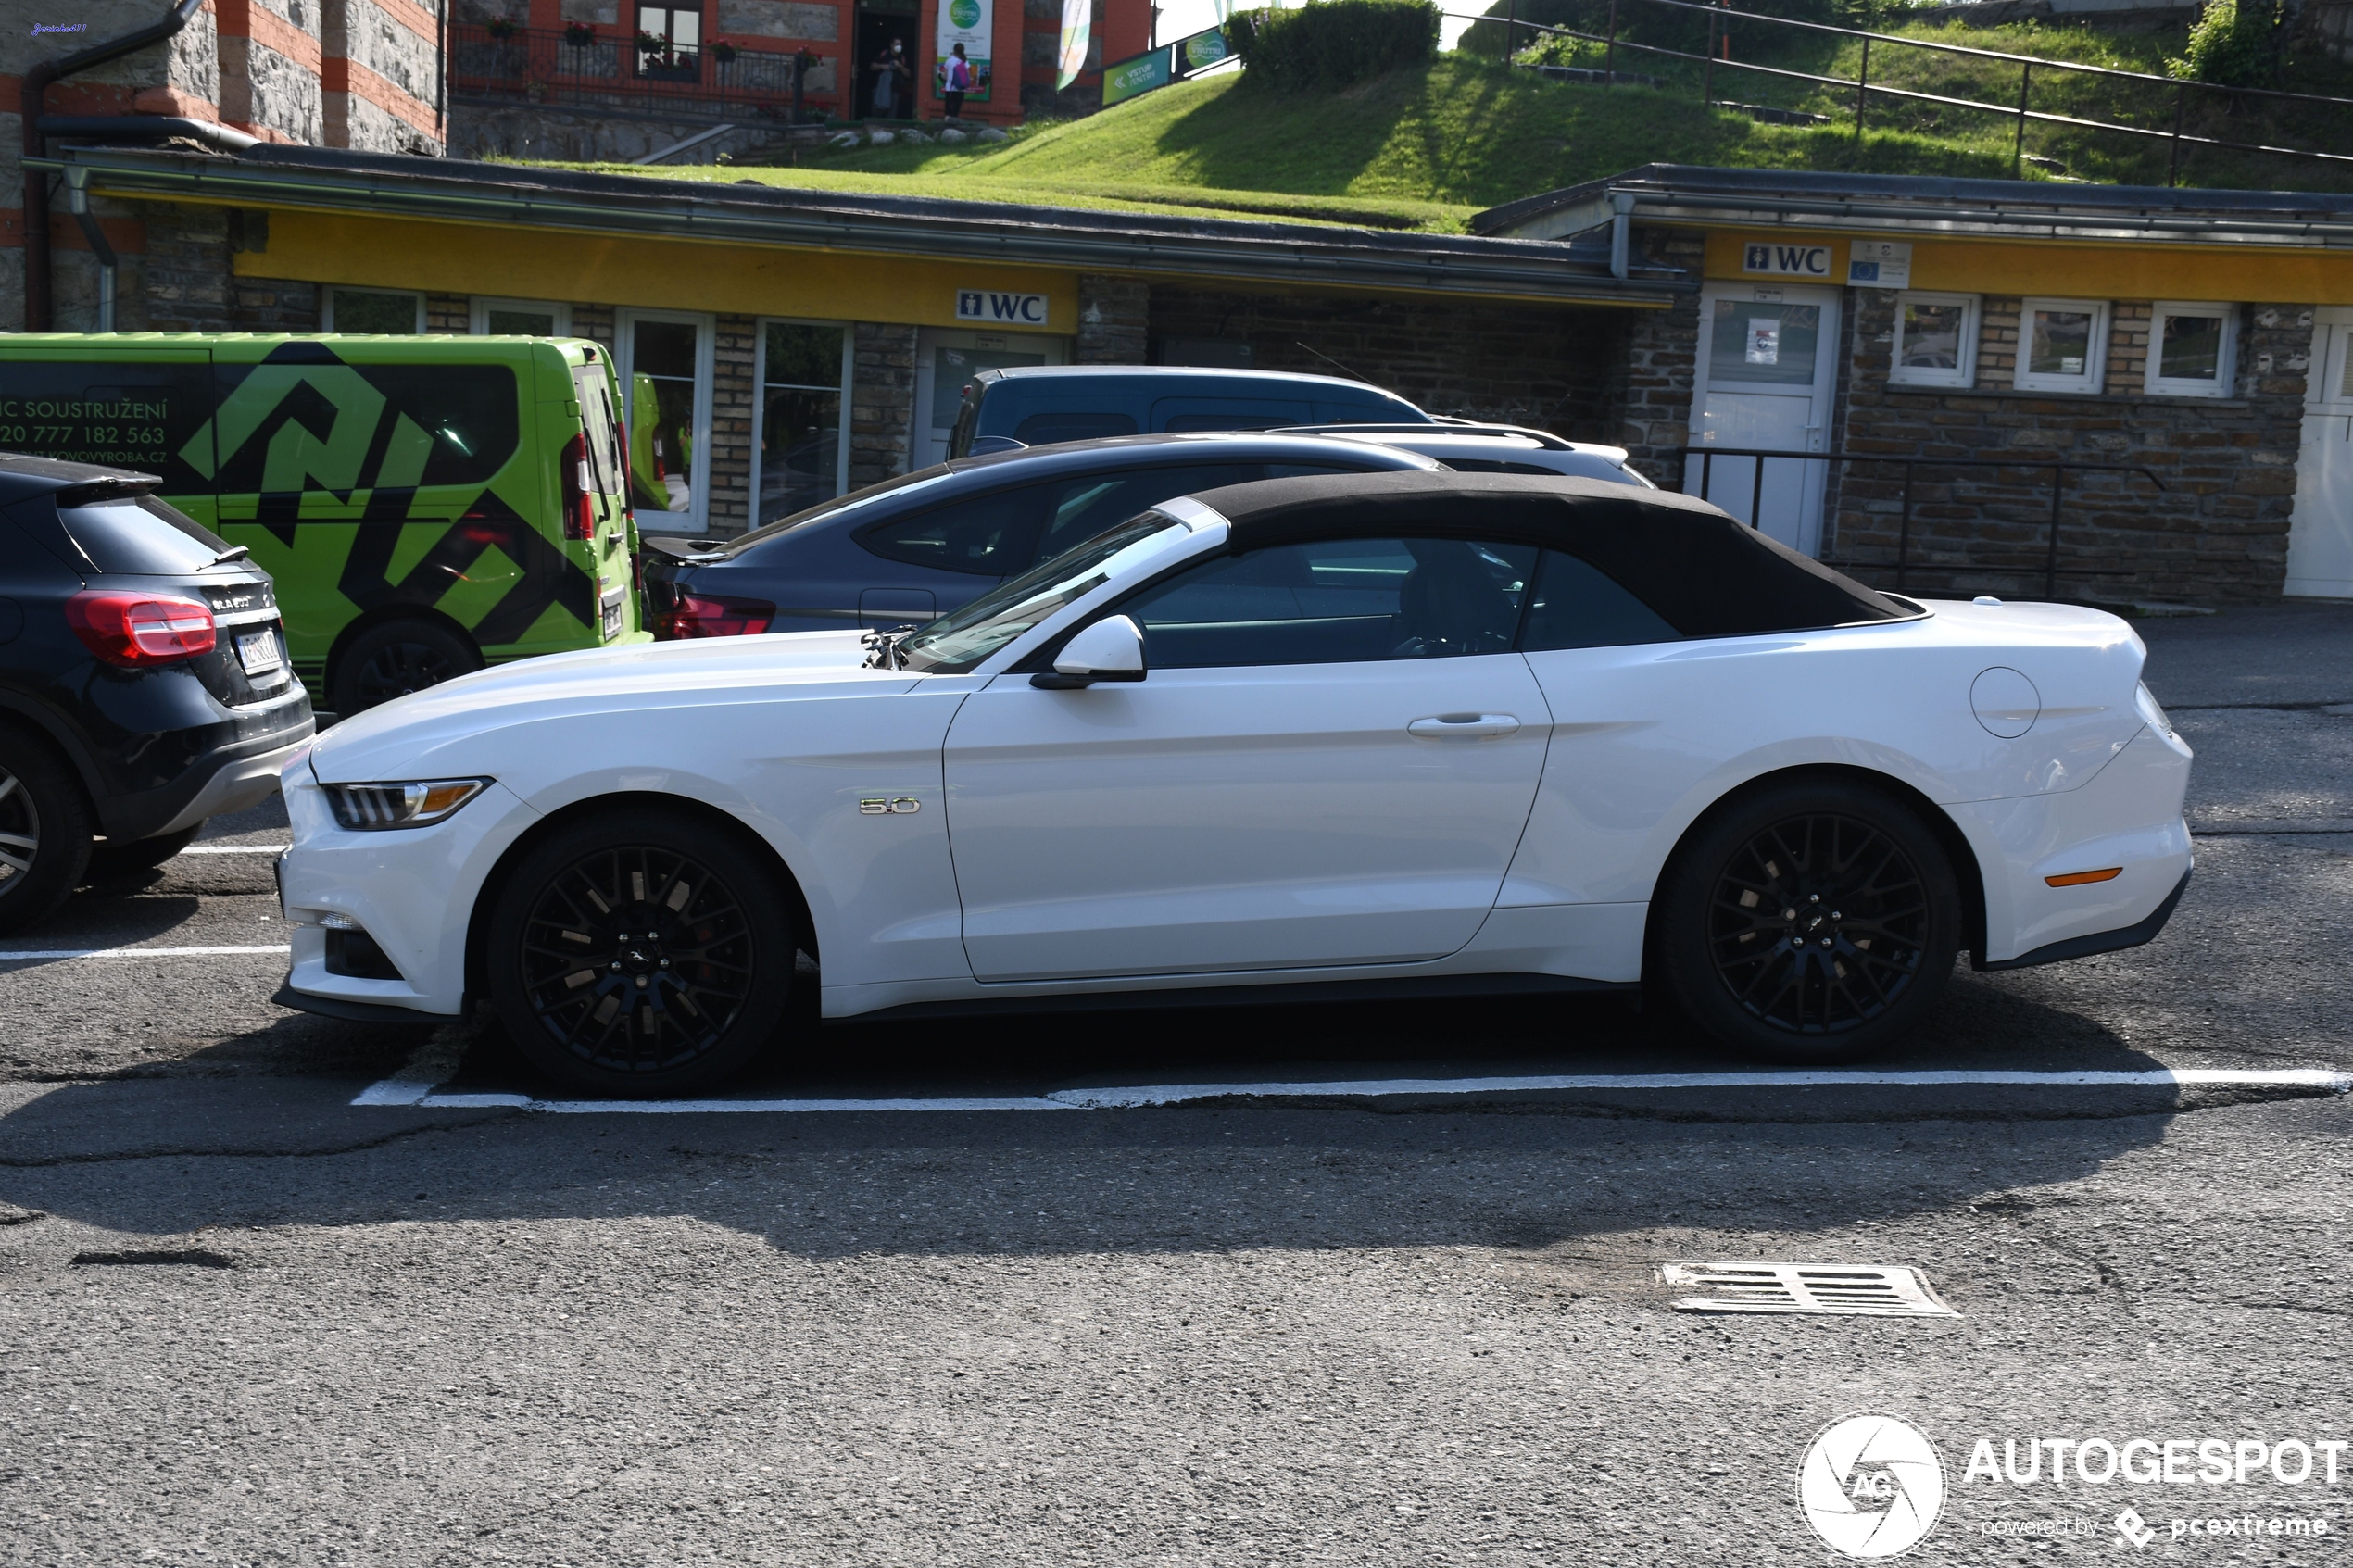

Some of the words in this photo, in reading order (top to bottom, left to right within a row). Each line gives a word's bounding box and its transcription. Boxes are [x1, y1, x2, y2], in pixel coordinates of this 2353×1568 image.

[1190, 46, 1222, 56] VNUTRI
[1127, 63, 1153, 78] VSTUP
[1776, 246, 1825, 274] WC
[988, 294, 1042, 322] WC
[25, 397, 168, 419] SOUSTRUŽENÍ
[33, 426, 73, 443] 777
[84, 426, 119, 443] 182
[126, 427, 165, 444] 563
[860, 797, 921, 815] 5.0
